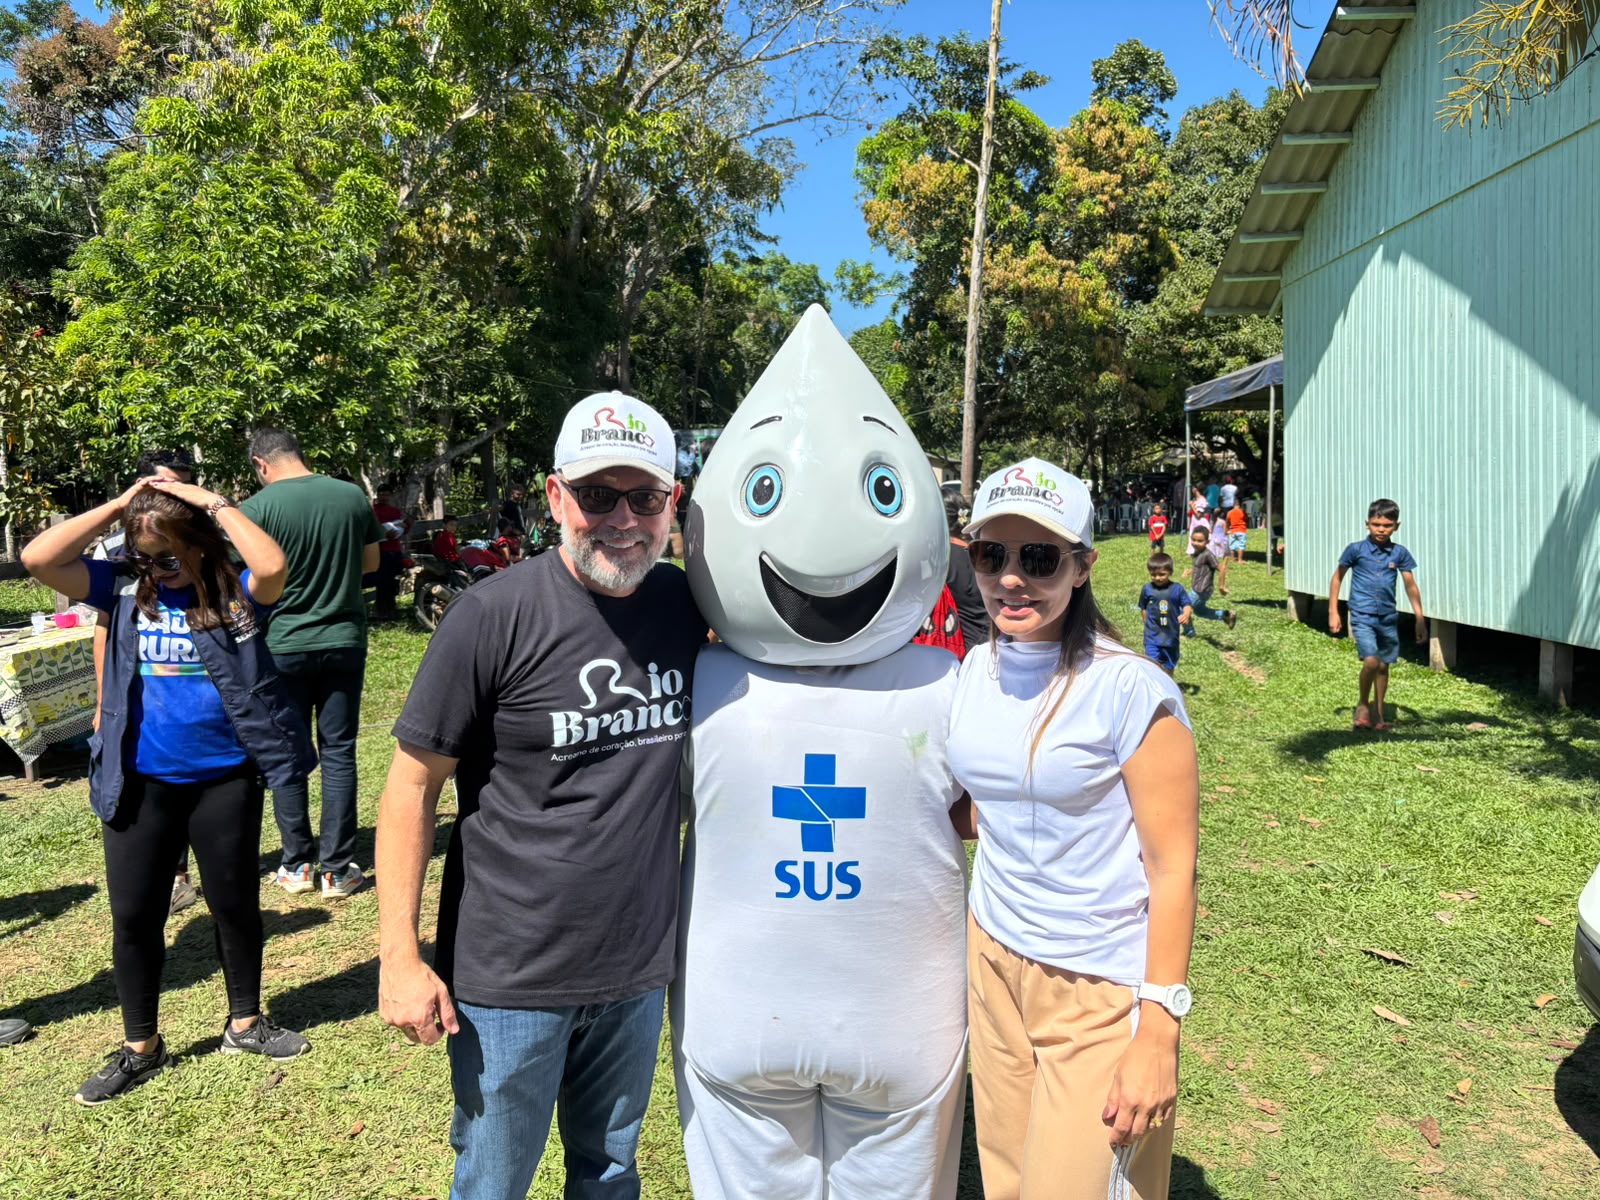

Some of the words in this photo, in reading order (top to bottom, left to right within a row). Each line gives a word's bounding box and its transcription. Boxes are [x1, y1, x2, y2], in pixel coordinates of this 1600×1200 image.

[551, 748, 587, 762] Acreano
[588, 745, 600, 755] de
[601, 738, 637, 751] coração,
[637, 732, 674, 746] brasileiro
[774, 860, 862, 901] SUS
